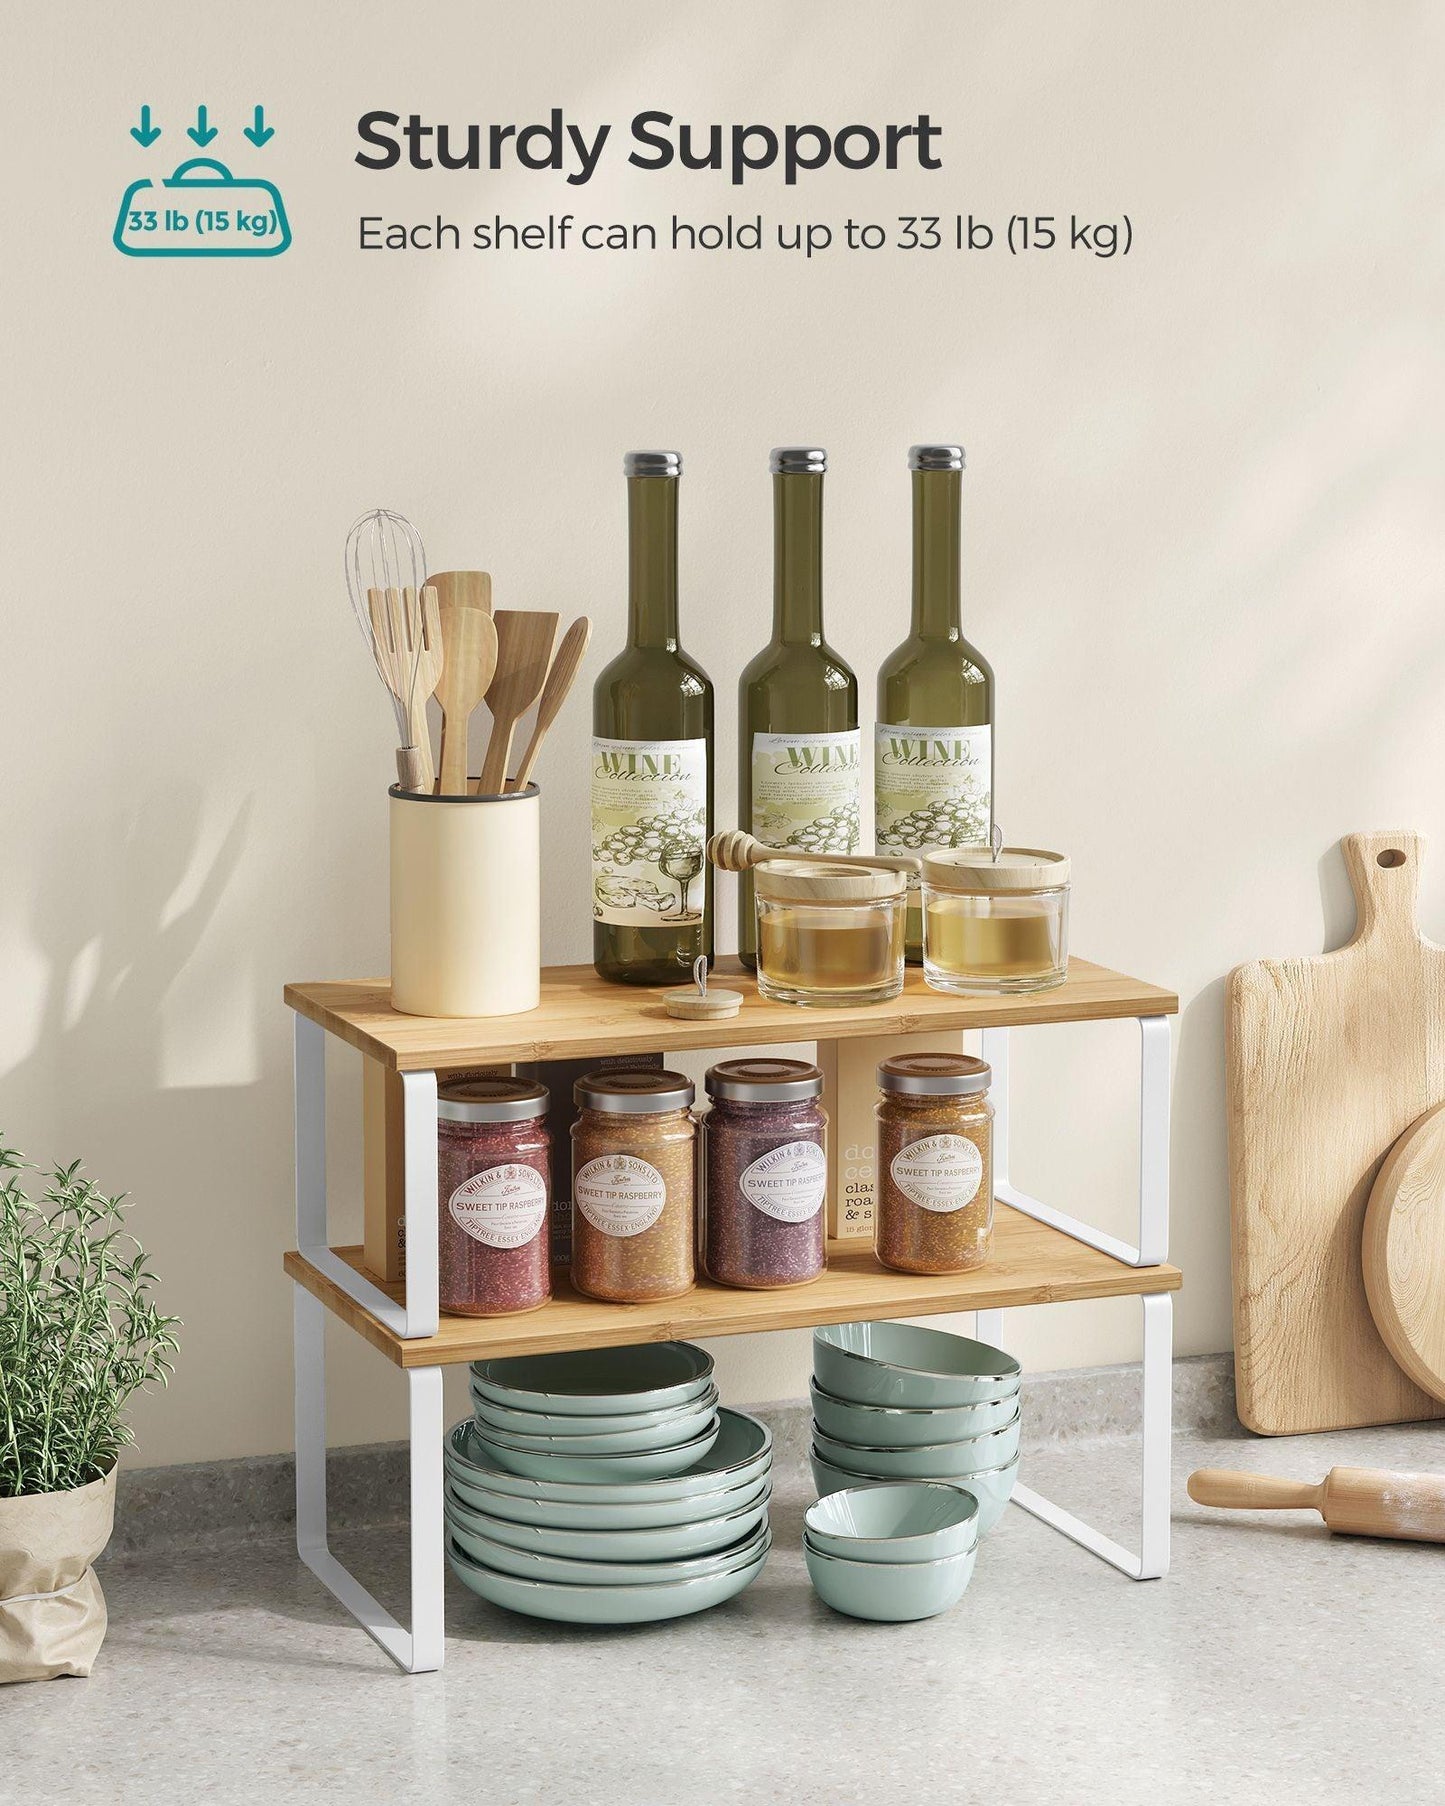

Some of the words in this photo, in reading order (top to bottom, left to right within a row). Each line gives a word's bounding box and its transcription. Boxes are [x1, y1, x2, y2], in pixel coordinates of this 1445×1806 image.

[889, 738, 971, 760] WINE
[601, 751, 681, 775] WINE
[882, 752, 980, 767] Collection
[595, 765, 692, 781] Collection
[904, 1142, 930, 1160] WILKIN
[756, 1150, 785, 1172] WILKIN
[583, 1161, 605, 1179] WILKIN
[897, 1167, 928, 1176] SWEET
[944, 1167, 980, 1177] RASPBERRY
[464, 1173, 494, 1194] WILKIN
[786, 1179, 797, 1187] TIP
[578, 1186, 603, 1198] SWEET
[618, 1191, 662, 1200] RASPBERRY
[456, 1202, 492, 1211] SWEET
[845, 1209, 860, 1220] &
